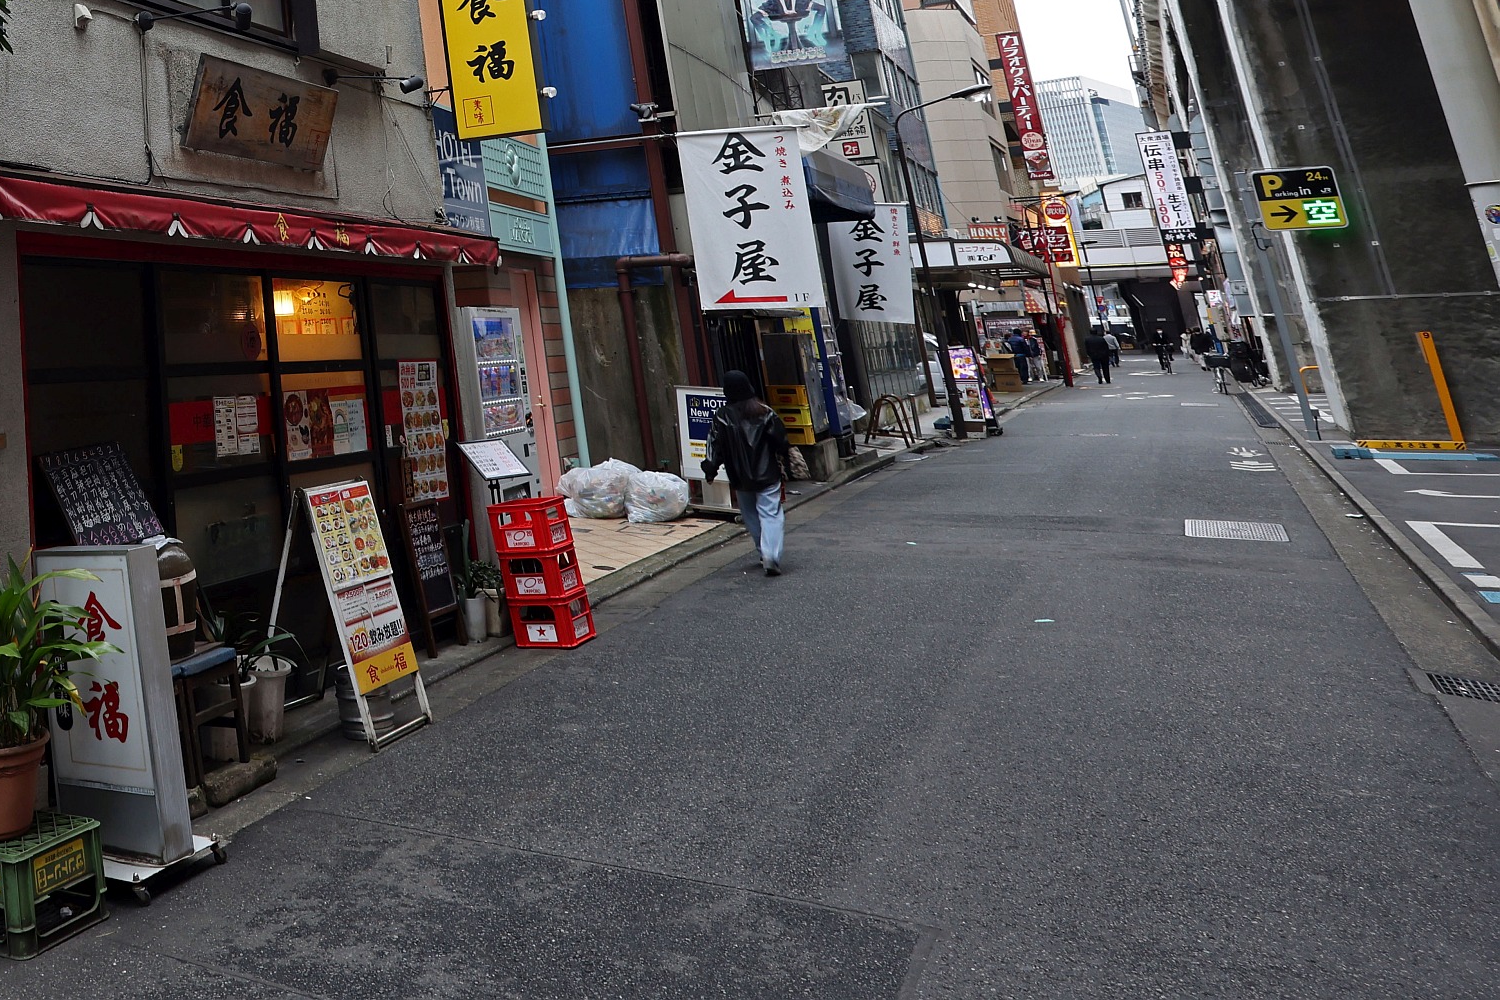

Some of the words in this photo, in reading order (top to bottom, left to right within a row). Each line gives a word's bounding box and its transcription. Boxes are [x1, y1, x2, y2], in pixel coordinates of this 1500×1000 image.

[1000, 35, 1032, 130] カラオケ&パーティー
[212, 76, 301, 148] 食福
[844, 144, 859, 155] 2F
[1139, 134, 1170, 142] 大衆酒場
[1143, 144, 1165, 171] 伝串
[446, 167, 483, 204] Town
[1260, 174, 1300, 198] Parking
[1298, 186, 1312, 196] in
[1305, 172, 1328, 182] 24H
[780, 175, 796, 210] 煮込み
[711, 132, 779, 285] 金子屋
[1046, 206, 1065, 215] 消火栓
[1167, 193, 1188, 228] 生ビール
[1303, 200, 1341, 224] 空
[273, 212, 350, 247] 食福
[890, 207, 899, 237] 焼きとん
[969, 227, 1006, 237] HONEY
[958, 245, 1001, 253] ユニフォーム
[1165, 232, 1198, 241] 新時代
[848, 219, 888, 311] 金子屋
[690, 407, 710, 417] New
